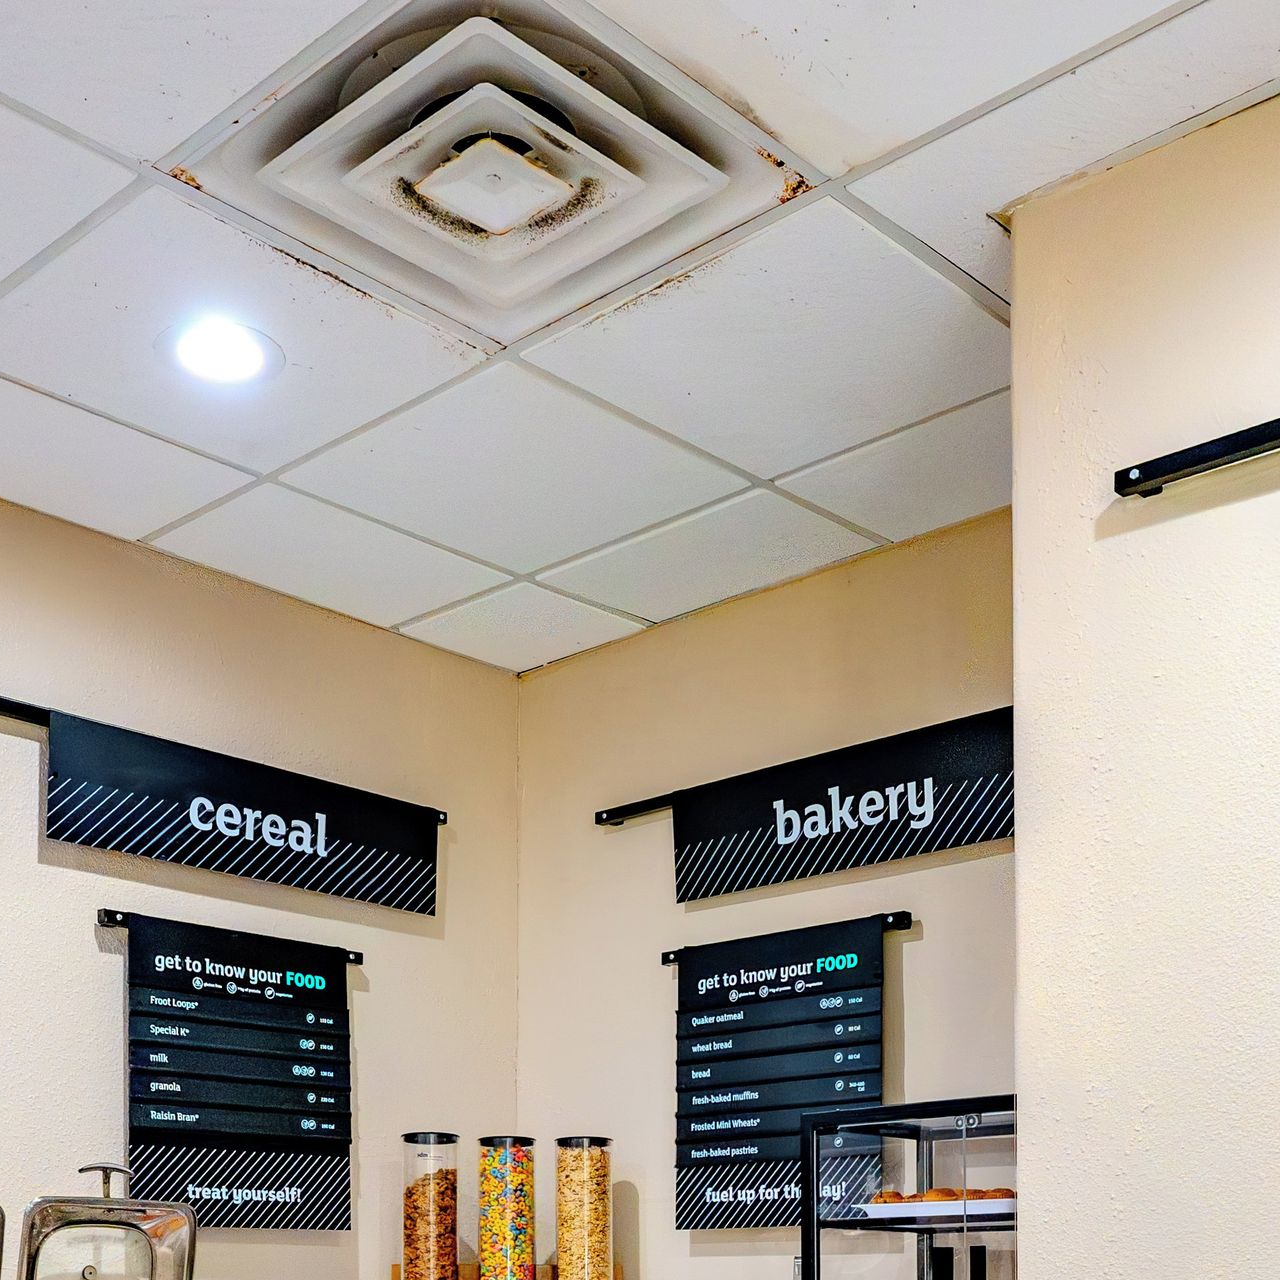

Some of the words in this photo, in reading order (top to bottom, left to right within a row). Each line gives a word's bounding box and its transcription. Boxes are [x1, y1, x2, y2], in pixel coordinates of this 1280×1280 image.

[774, 777, 936, 847] bakery
[189, 794, 329, 858] cereal
[155, 955, 181, 971] get
[185, 957, 201, 972] to
[205, 958, 245, 978] know
[249, 969, 282, 984] your
[286, 971, 325, 989] FOOD
[698, 975, 720, 994] get
[723, 973, 737, 986] to
[740, 968, 777, 987] know
[781, 963, 814, 985] your
[817, 954, 857, 972] FOOD
[150, 995, 171, 1006] Froot
[691, 1013, 715, 1027] Quaker
[716, 1011, 744, 1023] oatmeal
[150, 1024, 179, 1036] Special
[691, 1043, 712, 1053] wheat
[713, 1039, 732, 1051] bread
[150, 1052, 168, 1063] milk
[691, 1068, 710, 1079] bread
[150, 1082, 181, 1092] granola
[692, 1093, 731, 1105] fresh-baked
[732, 1090, 759, 1102] muffins
[150, 1111, 175, 1121] Raisin
[691, 1120, 715, 1131] Frosted
[716, 1119, 731, 1130] Mini
[691, 1147, 730, 1159] fresh-baked
[731, 1145, 758, 1157] pastries
[187, 1183, 229, 1200] treat
[233, 1187, 301, 1205] yourself!
[705, 1185, 734, 1203] fuel
[737, 1187, 755, 1204] up
[758, 1184, 779, 1200] for
[783, 1183, 801, 1199] th
